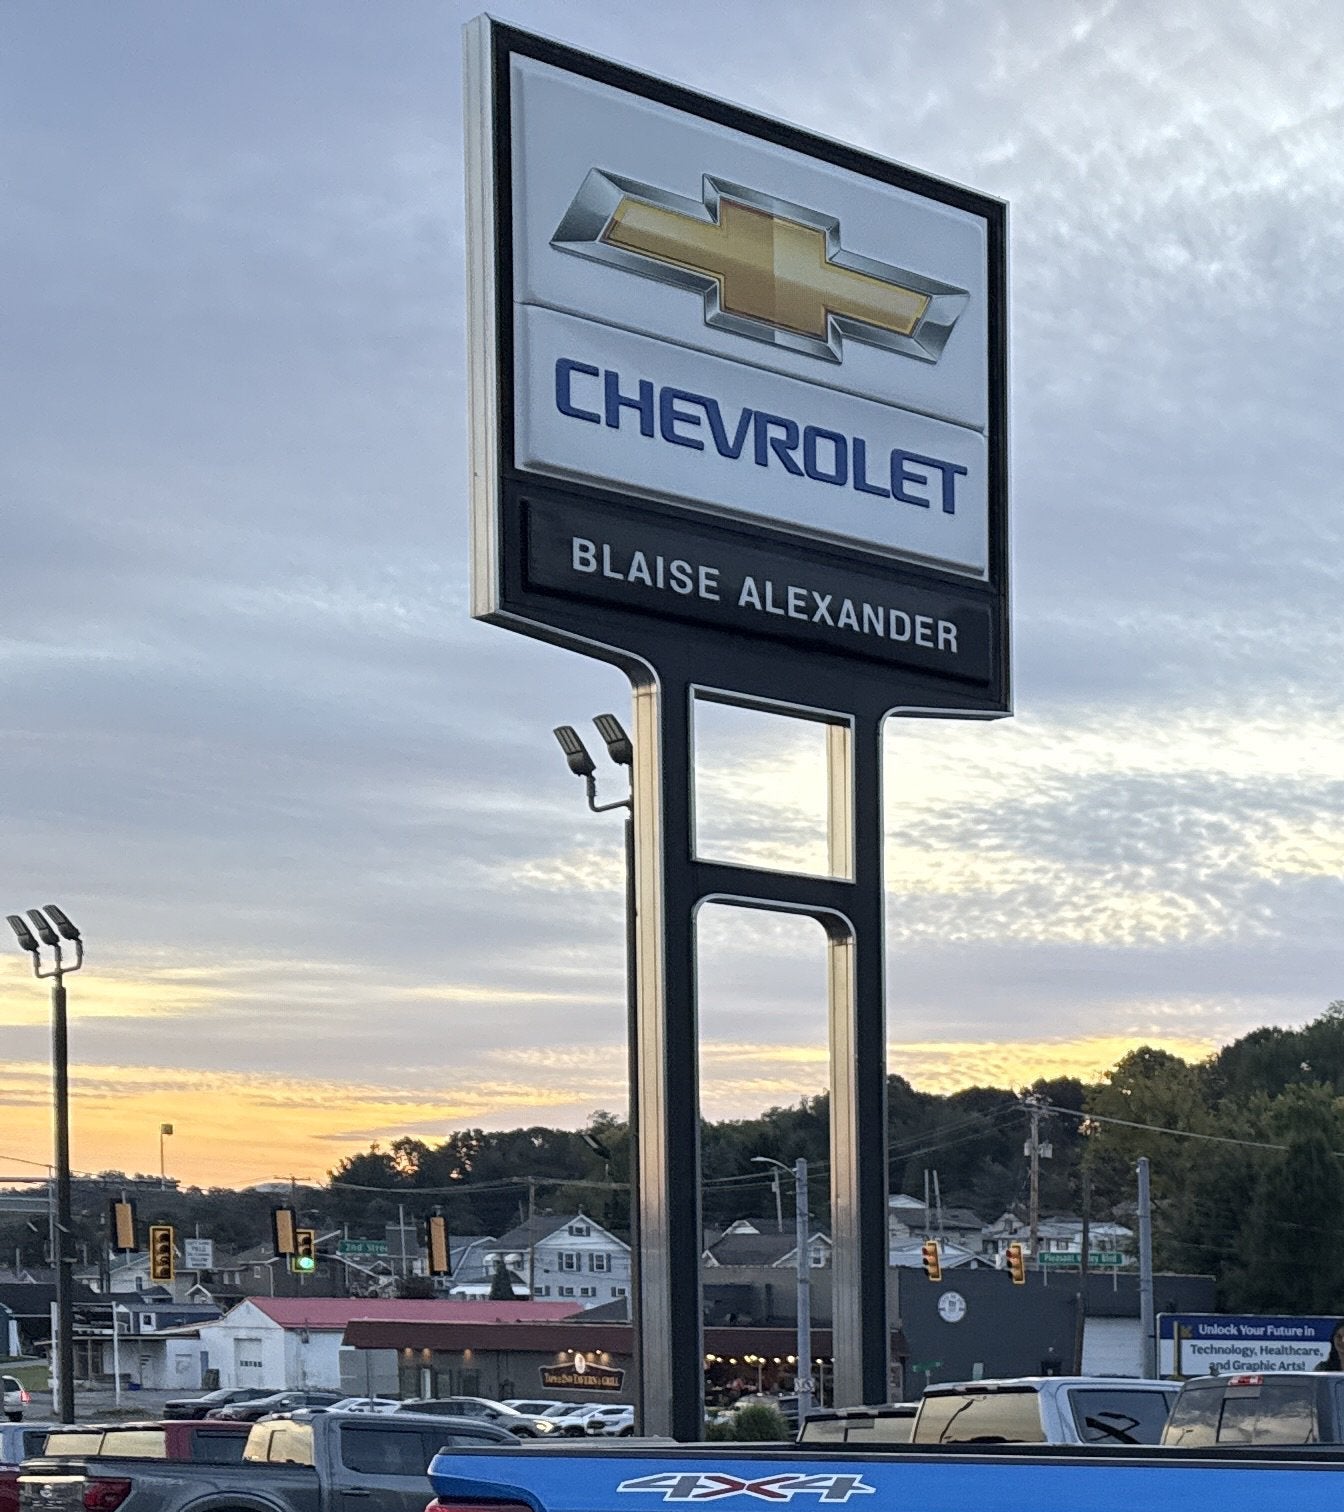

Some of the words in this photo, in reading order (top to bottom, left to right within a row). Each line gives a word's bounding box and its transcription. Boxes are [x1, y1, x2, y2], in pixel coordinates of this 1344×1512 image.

[555, 357, 968, 515] CHEVROLET
[572, 536, 720, 601] BLAISE
[737, 576, 959, 653] ALEXANDER
[1198, 1324, 1239, 1335] Unlock
[1240, 1325, 1266, 1336] Your
[1267, 1325, 1303, 1337] Future
[1190, 1344, 1258, 1358] Technology,
[1259, 1345, 1324, 1357] Healthcare,
[1209, 1360, 1230, 1371] and
[1232, 1360, 1277, 1372] Graphic
[1279, 1361, 1306, 1371] Arts!
